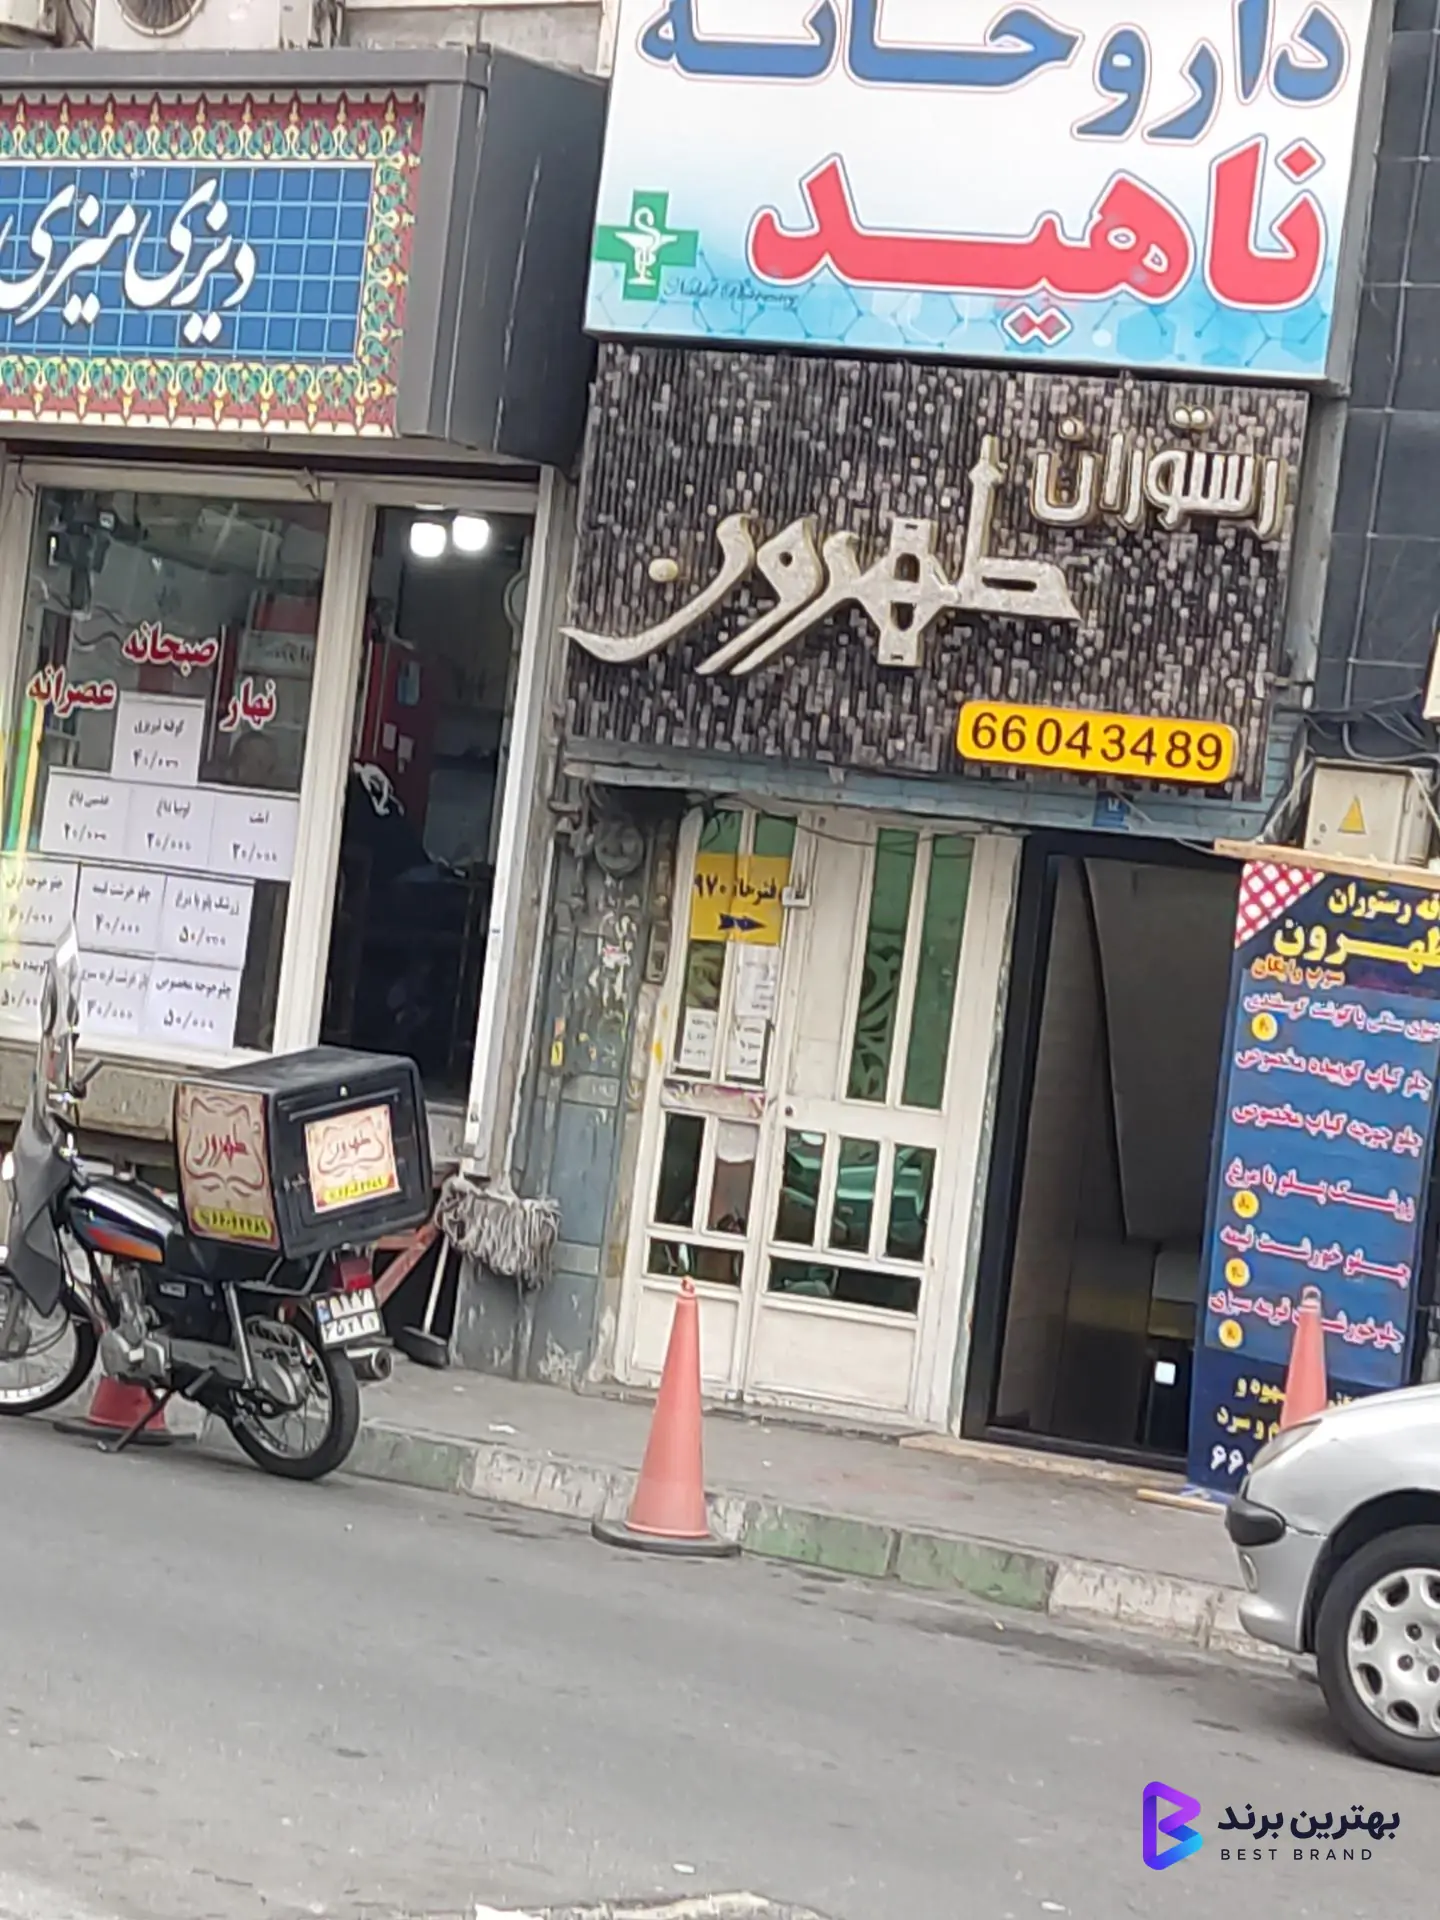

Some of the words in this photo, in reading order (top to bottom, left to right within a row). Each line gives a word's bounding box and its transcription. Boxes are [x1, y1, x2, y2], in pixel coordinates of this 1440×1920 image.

[124, 178, 256, 343] دیزی
[750, 138, 1324, 346] ناهید
[1031, 404, 1289, 539] رستوران
[122, 621, 219, 678] صبحانه
[26, 664, 118, 719] عصرانه
[219, 677, 278, 732] نهار
[971, 712, 1222, 772] 66043489
[1328, 882, 1412, 925] رستوران
[1216, 1406, 1252, 1434] سرد
